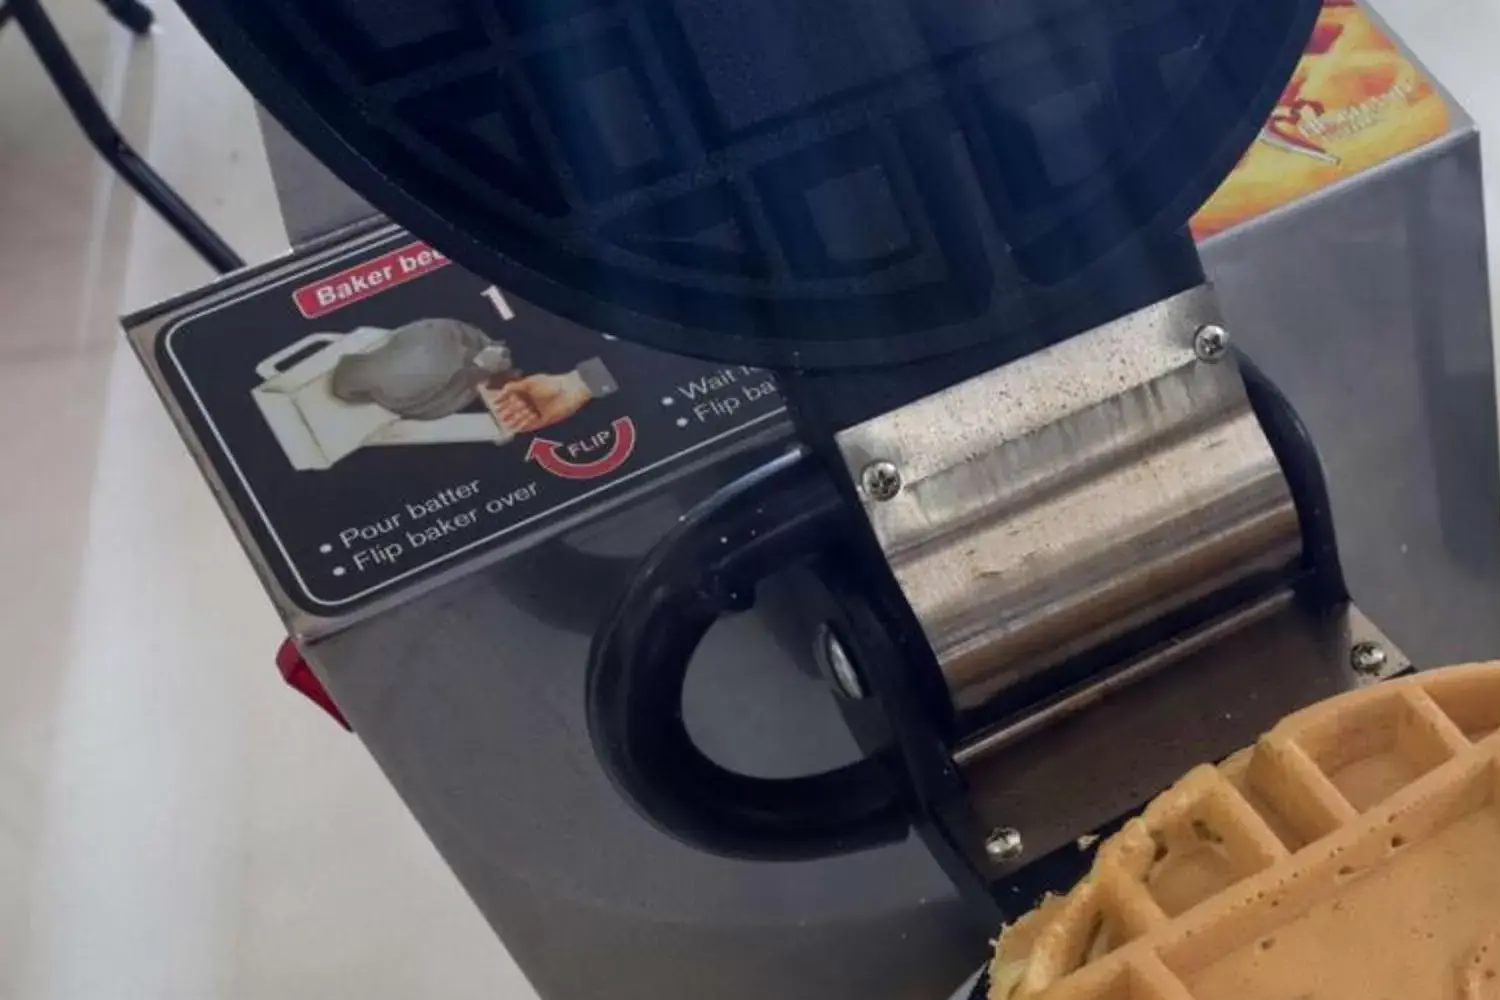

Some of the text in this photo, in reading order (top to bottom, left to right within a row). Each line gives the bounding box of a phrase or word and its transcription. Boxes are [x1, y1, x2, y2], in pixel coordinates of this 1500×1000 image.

[315, 264, 393, 307] Baker
[480, 284, 516, 321] 1
[677, 369, 736, 400] Wait
[693, 373, 777, 422] Flip ba
[567, 430, 612, 458] FLIP
[339, 479, 481, 549] Pour batter
[352, 481, 538, 571] Flip baker over
